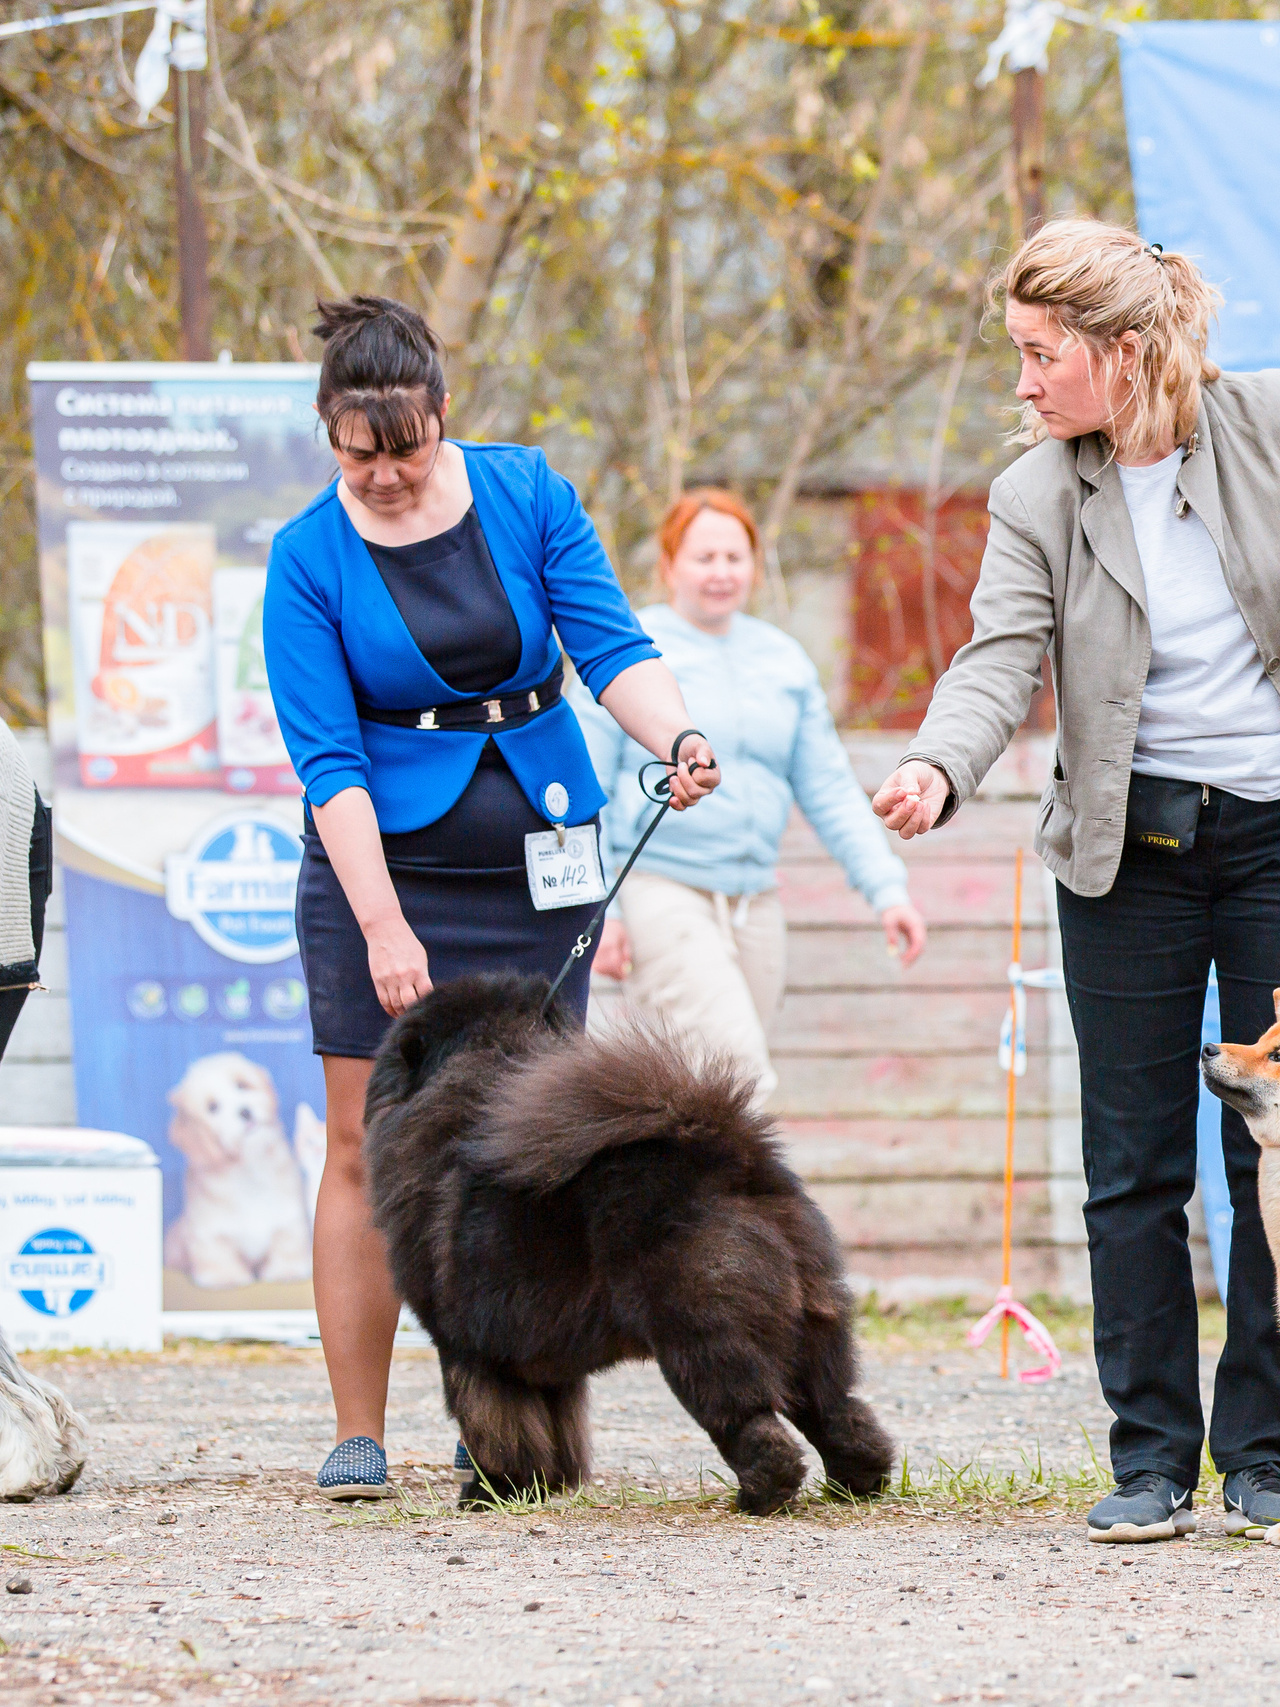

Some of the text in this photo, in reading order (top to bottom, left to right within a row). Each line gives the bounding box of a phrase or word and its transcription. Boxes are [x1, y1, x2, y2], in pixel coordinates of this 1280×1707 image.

[1147, 835, 1180, 848] PRIORI
[186, 872, 297, 900] Farmin
[560, 864, 588, 888] 142
